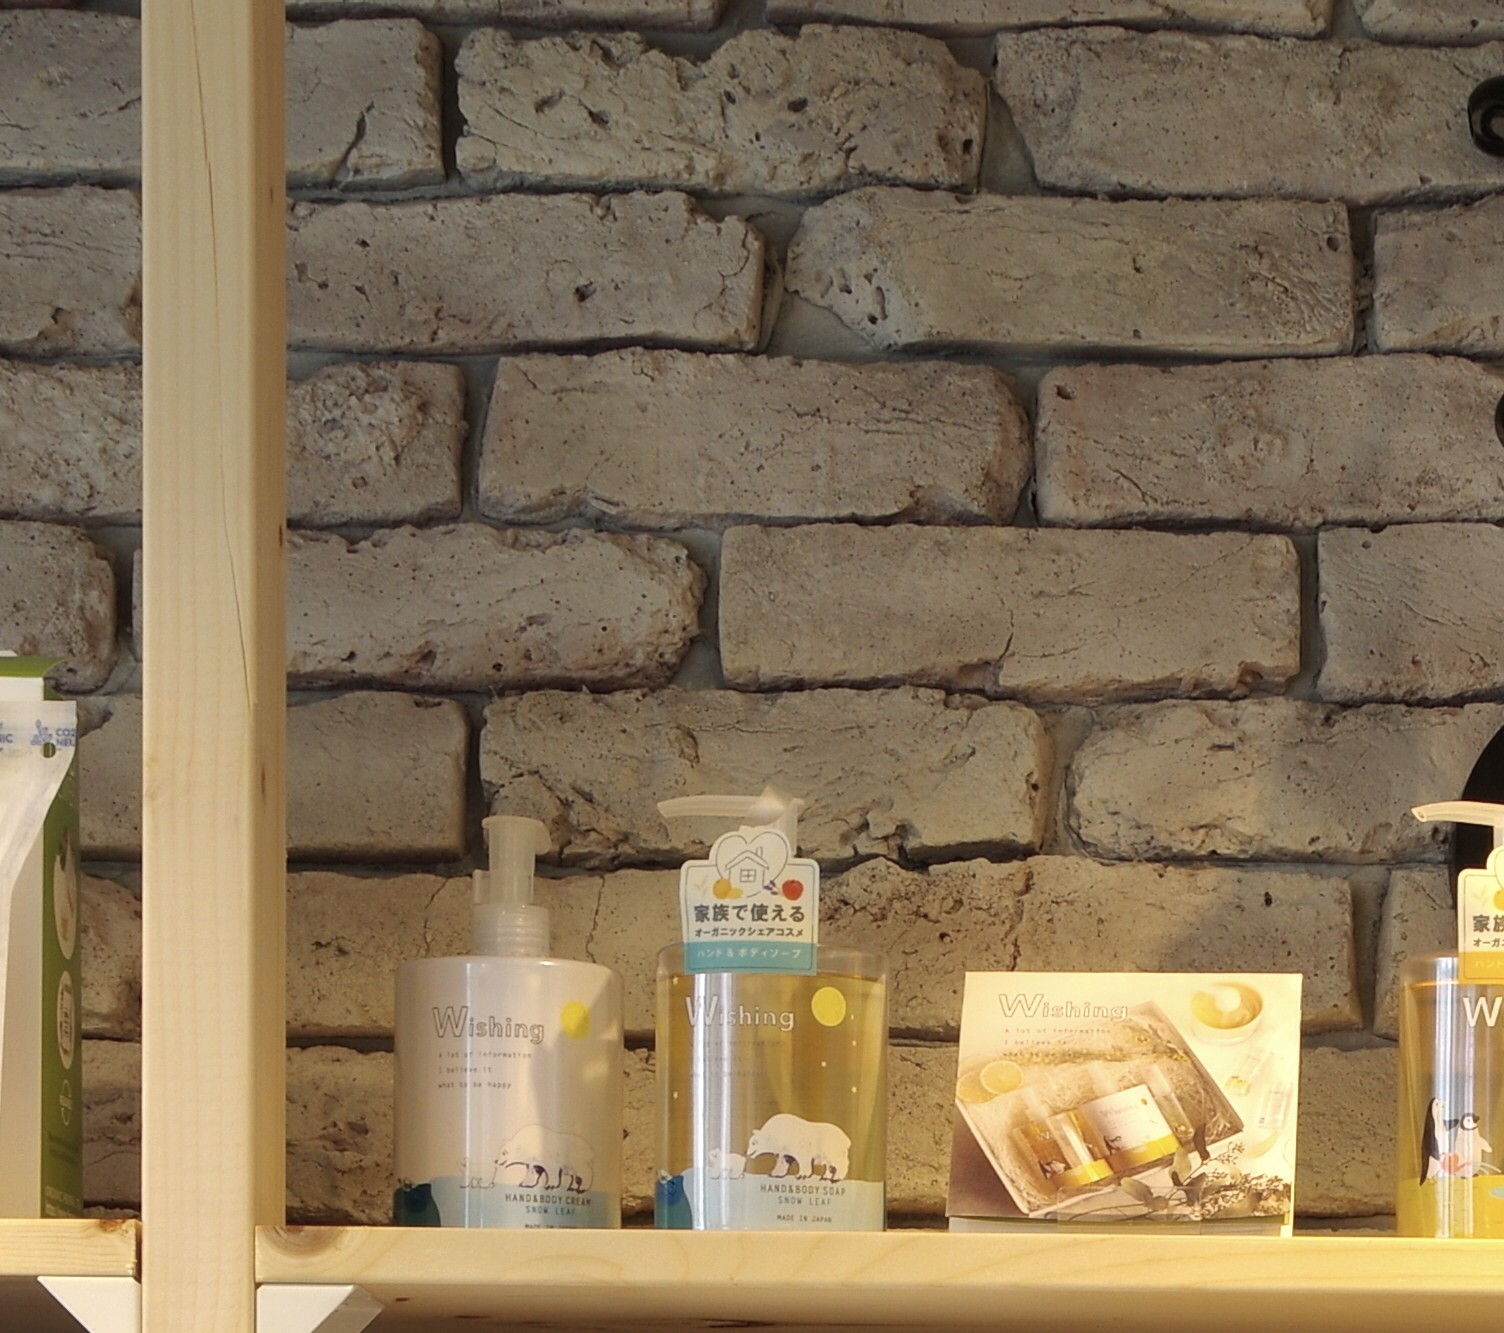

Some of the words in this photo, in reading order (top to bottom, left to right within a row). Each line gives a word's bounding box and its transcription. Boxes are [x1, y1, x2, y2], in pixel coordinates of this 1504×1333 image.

[694, 904, 804, 922] 家族で使える
[695, 927, 803, 937] オーガニックシェアコスメ
[686, 995, 794, 1031] Wishing
[999, 994, 1128, 1021] Wishing
[433, 1006, 544, 1044] Wishing
